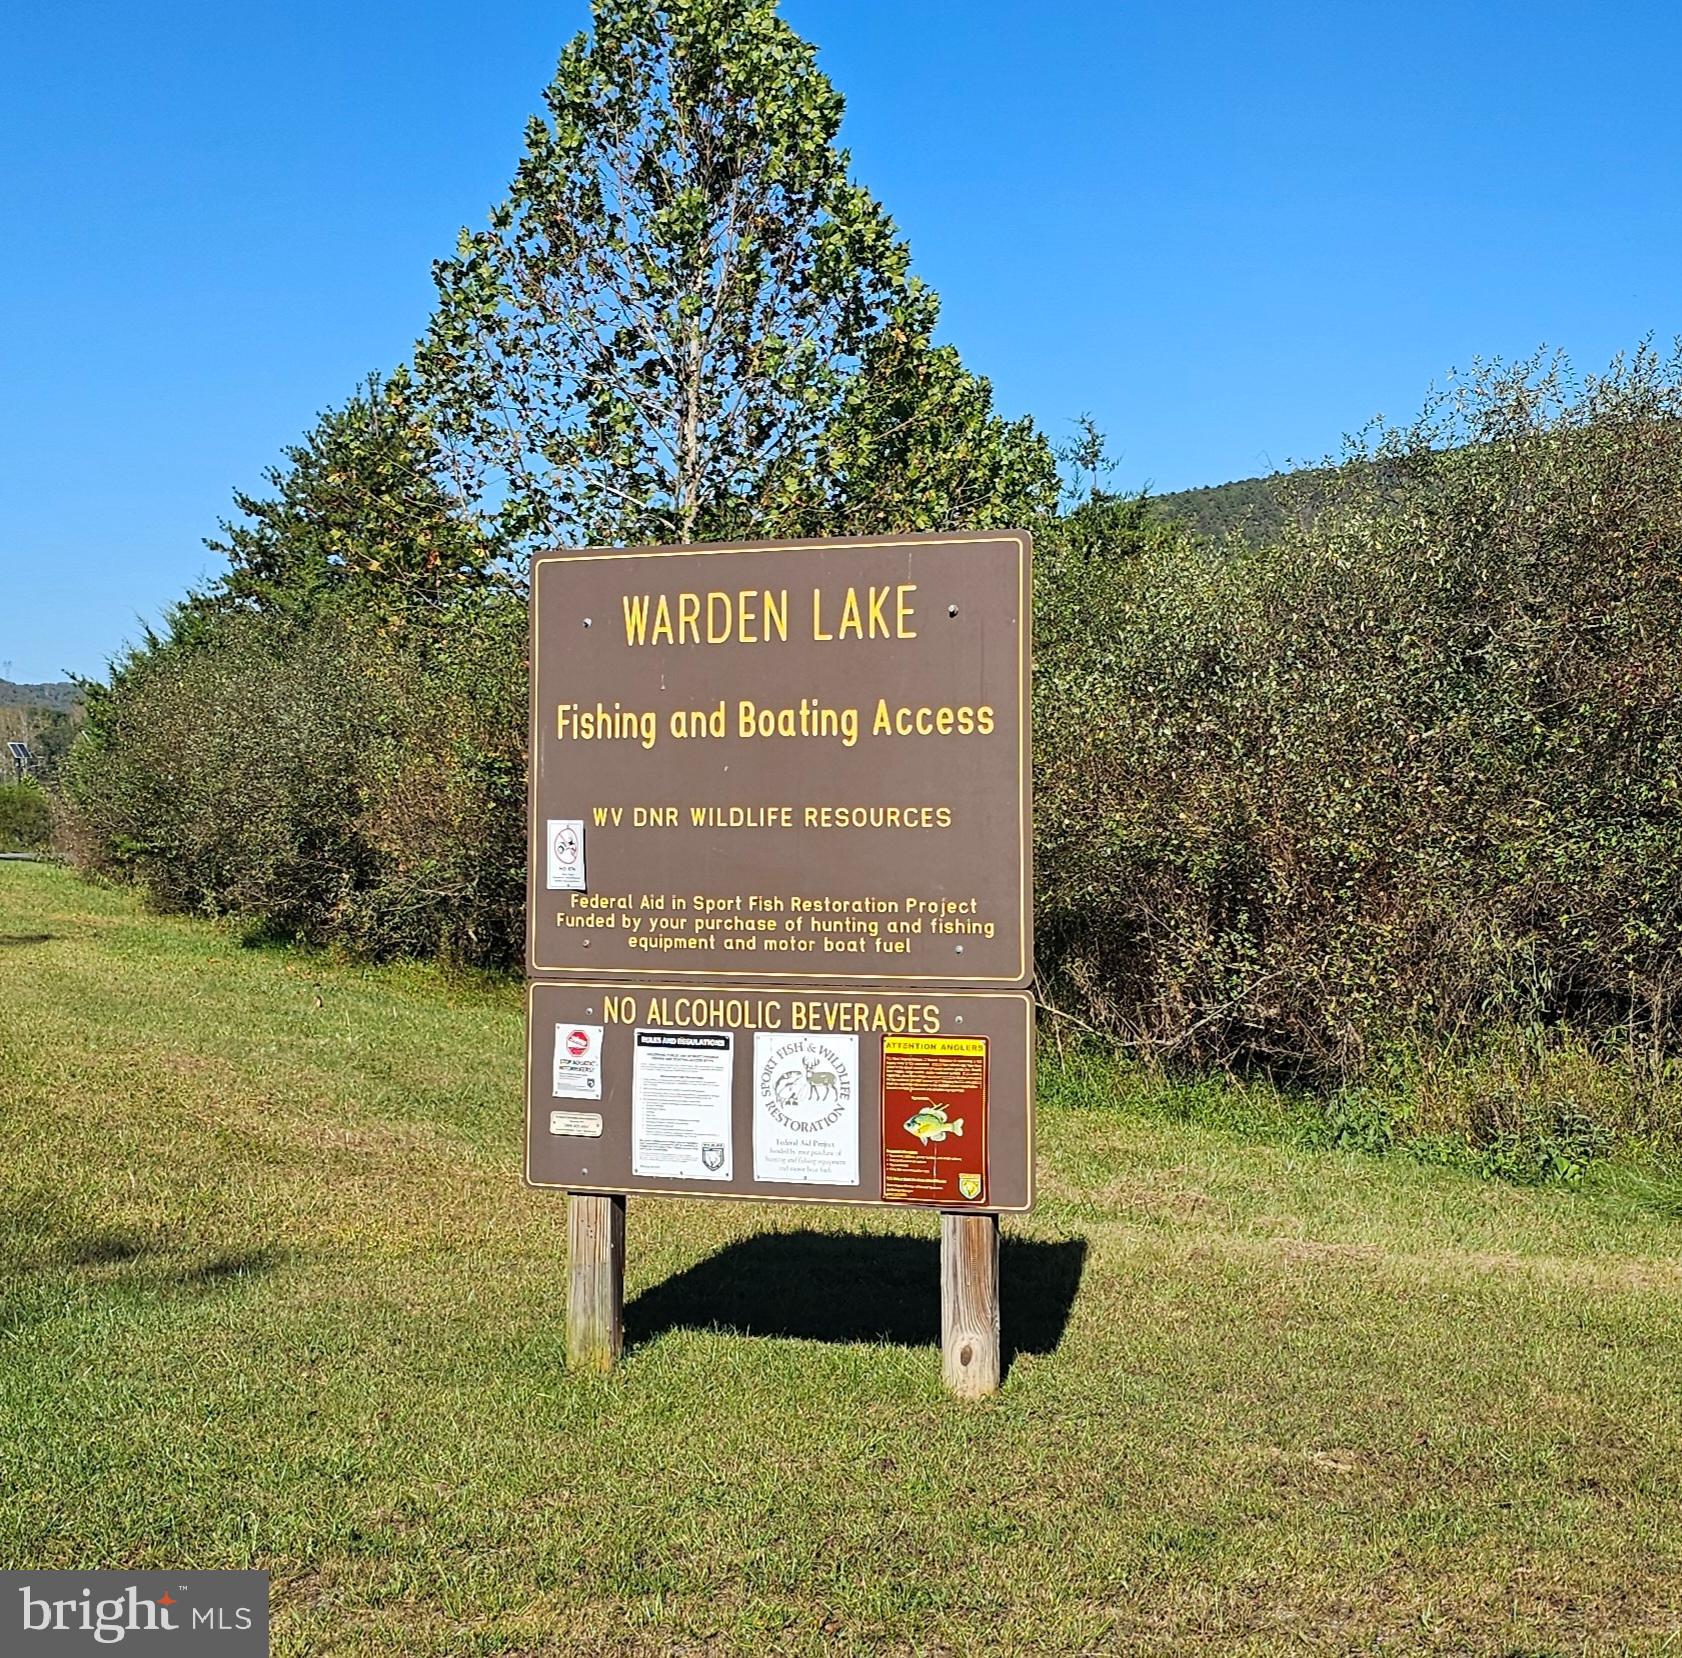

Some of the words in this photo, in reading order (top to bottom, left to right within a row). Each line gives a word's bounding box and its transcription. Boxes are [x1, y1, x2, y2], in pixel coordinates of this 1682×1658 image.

[622, 588, 788, 647] WARDEN
[813, 584, 918, 641] LAKE
[556, 702, 657, 750] Fishing
[669, 700, 726, 739] and
[738, 698, 859, 748] Boating
[872, 698, 996, 736] Access
[592, 807, 623, 828] WV
[633, 807, 679, 828] DNR
[689, 807, 793, 828] WILDLIFE
[804, 807, 952, 829] RESOURCES
[571, 893, 633, 909] Federal
[640, 895, 665, 910] Aid
[672, 895, 686, 910] in
[693, 896, 741, 914] Sport
[749, 896, 784, 912] Fish
[791, 897, 898, 913] Restoration
[906, 898, 977, 917] Project
[556, 913, 615, 928] Funded
[622, 913, 642, 932] by
[649, 917, 687, 932] your
[694, 916, 777, 933] purchase
[785, 916, 803, 932] of
[811, 917, 879, 936] hunting
[887, 918, 922, 934] and
[930, 918, 995, 939] fishing
[628, 934, 715, 952] equipment
[724, 936, 756, 950] and
[764, 936, 815, 952] motor
[824, 937, 866, 953] boat
[875, 938, 911, 953] fuel
[603, 995, 636, 1025] NO
[647, 997, 782, 1029] ALCOHOLIC
[791, 1001, 941, 1034] BEVERAGES
[886, 1042, 937, 1050] ATTENTION
[941, 1044, 984, 1052] ANGLERS
[760, 1056, 778, 1097] SPORT
[776, 1041, 804, 1059] FISH
[807, 1043, 817, 1053] &
[819, 1045, 850, 1100] WILDLIFE
[765, 1100, 845, 1133] RESTORATION
